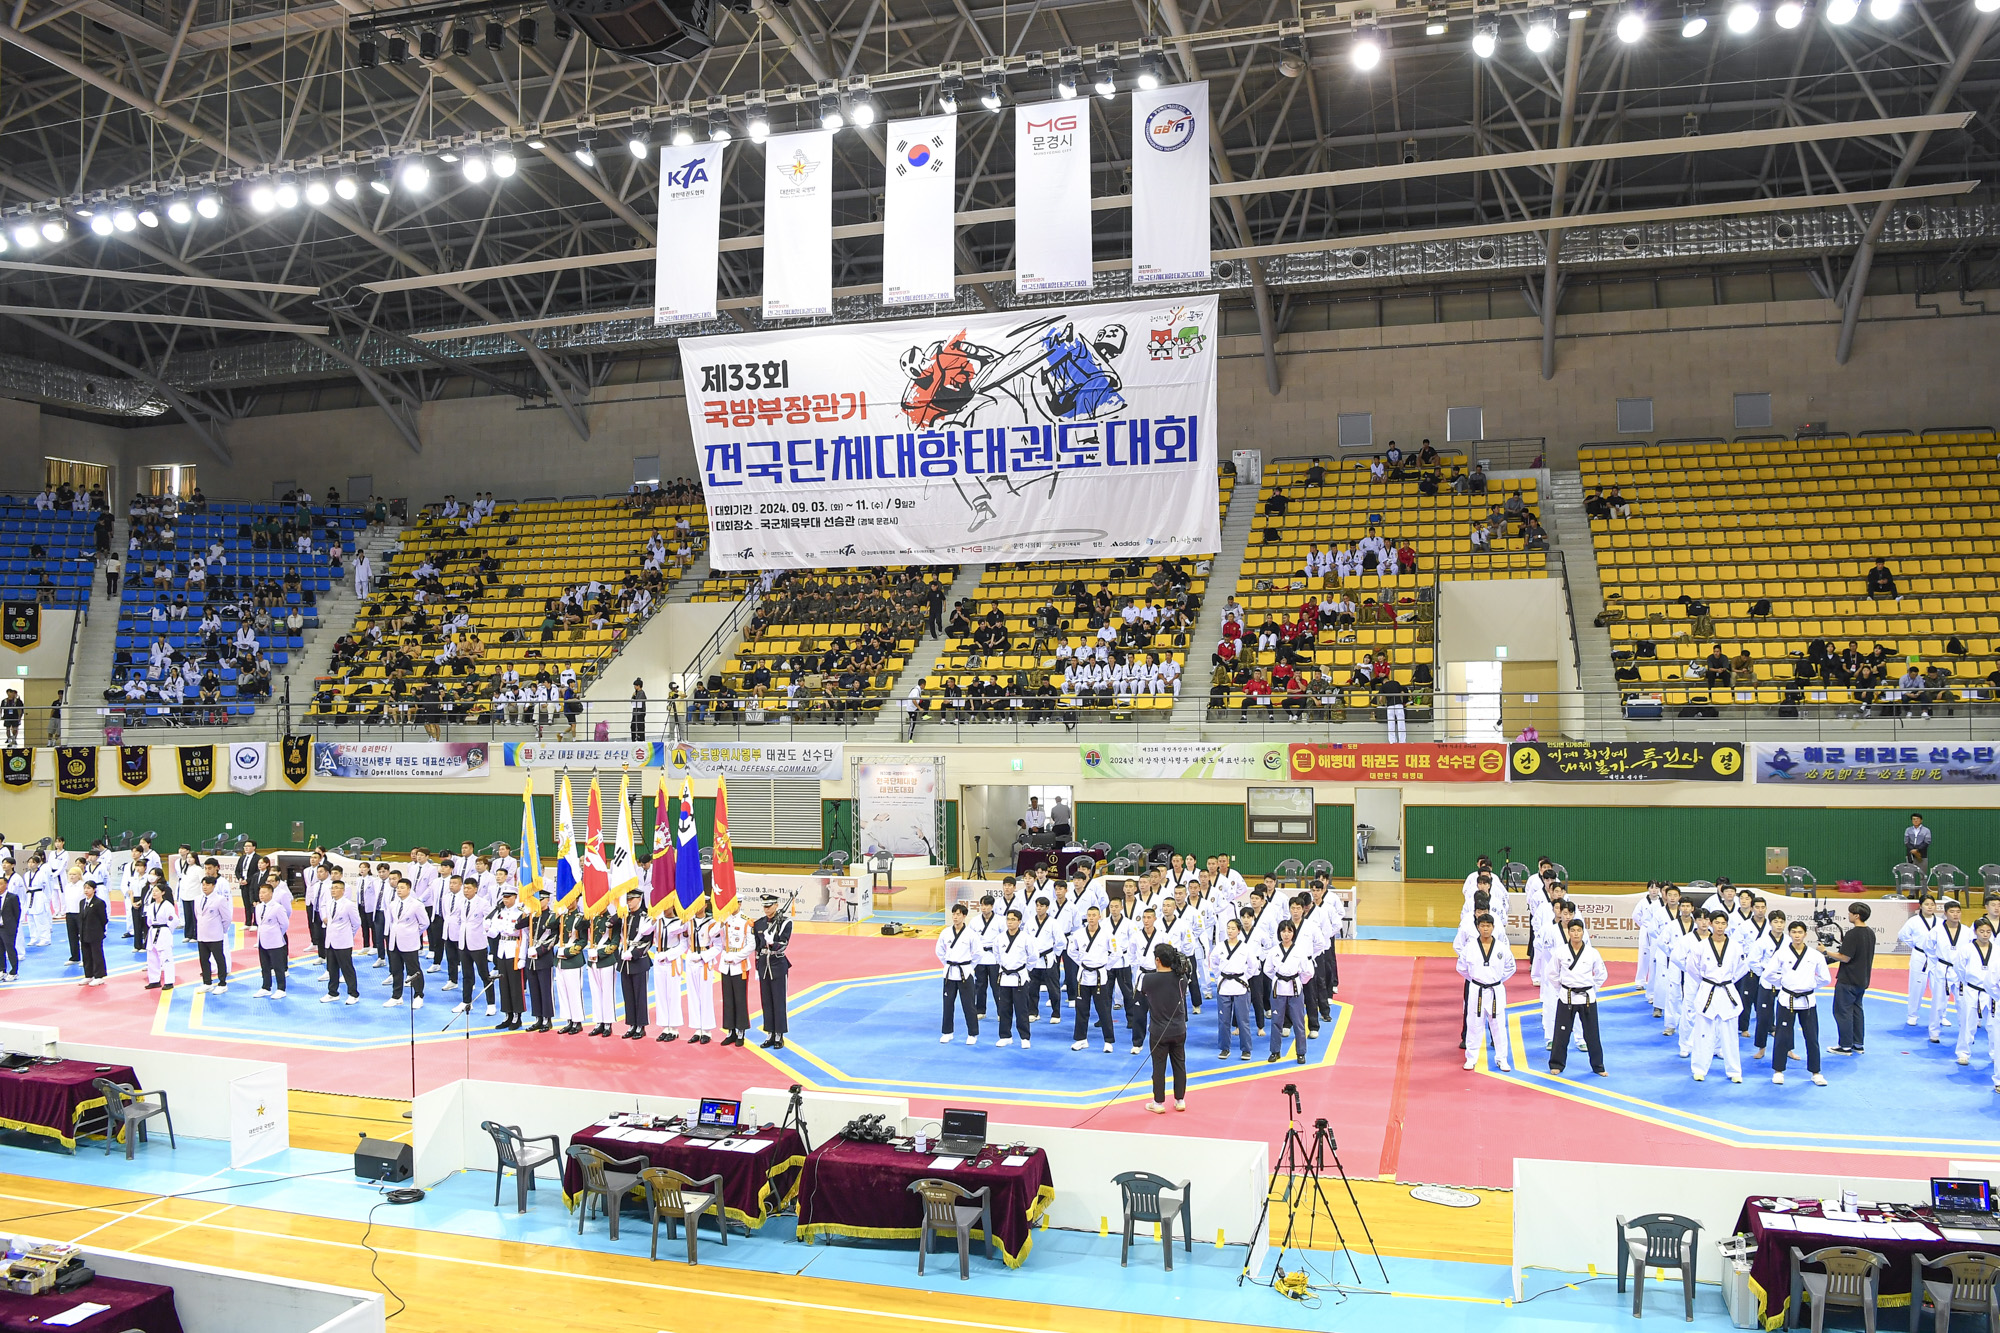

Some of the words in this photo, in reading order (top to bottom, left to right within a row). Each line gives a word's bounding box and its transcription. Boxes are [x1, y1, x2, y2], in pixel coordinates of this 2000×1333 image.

[1027, 115, 1077, 134] MG
[1032, 133, 1073, 151] 문경시
[668, 158, 709, 189] KTA
[700, 359, 789, 393] 제33회
[704, 391, 867, 428] 국방부장관기
[704, 415, 1198, 487] 전국단체대항태권도대회
[759, 502, 790, 514] 2024.
[792, 502, 809, 513] 09.
[811, 501, 828, 512] 03.
[830, 502, 844, 512] (화)
[856, 500, 869, 510] 11.
[871, 501, 884, 510] (수)
[895, 498, 916, 509] 9일간
[760, 517, 821, 530] 국군체육부대
[823, 516, 856, 528] 선승관
[961, 545, 982, 553] MG
[25, 607, 35, 616] 승
[62, 748, 72, 758] 필
[79, 747, 90, 757] 승
[338, 744, 358, 753] 반드시
[523, 748, 533, 760] 필
[539, 750, 555, 760] 공군
[557, 750, 574, 760] 대표
[576, 750, 600, 760] 태권도
[604, 750, 629, 761] 선수단
[635, 748, 645, 760] 승
[690, 748, 762, 762] 수도방위사령부
[766, 748, 797, 762] 태권도
[802, 748, 834, 762] 선수단
[1548, 749, 1579, 763] 세계
[1583, 747, 1627, 760] 최정예
[1804, 747, 1845, 763] 해군
[1855, 747, 1919, 763] 태권도
[1929, 747, 1994, 763] 선수단
[395, 756, 418, 767] 태권도
[422, 756, 462, 767] 대표선수단
[1109, 756, 1134, 765] 2024년
[1137, 756, 1190, 765] 지상작전사령부
[1192, 756, 1215, 764] 태권도
[1217, 756, 1255, 765] 대표선수단
[1295, 753, 1312, 769] 필
[1318, 754, 1356, 769] 해병대
[1361, 754, 1399, 769] 태권도
[1405, 754, 1431, 769] 대표
[1436, 754, 1476, 769] 선수단
[1482, 752, 1500, 769] 승
[1630, 747, 1704, 770] 특전사
[371, 769, 409, 777] Operations
[740, 765, 775, 773] DEFENSE
[778, 765, 818, 773] COMMAND
[1369, 772, 1398, 780] 대한민국
[1402, 772, 1424, 780] 해병대
[876, 777, 918, 786] 전국단체대항
[879, 786, 914, 794] 태권도대회
